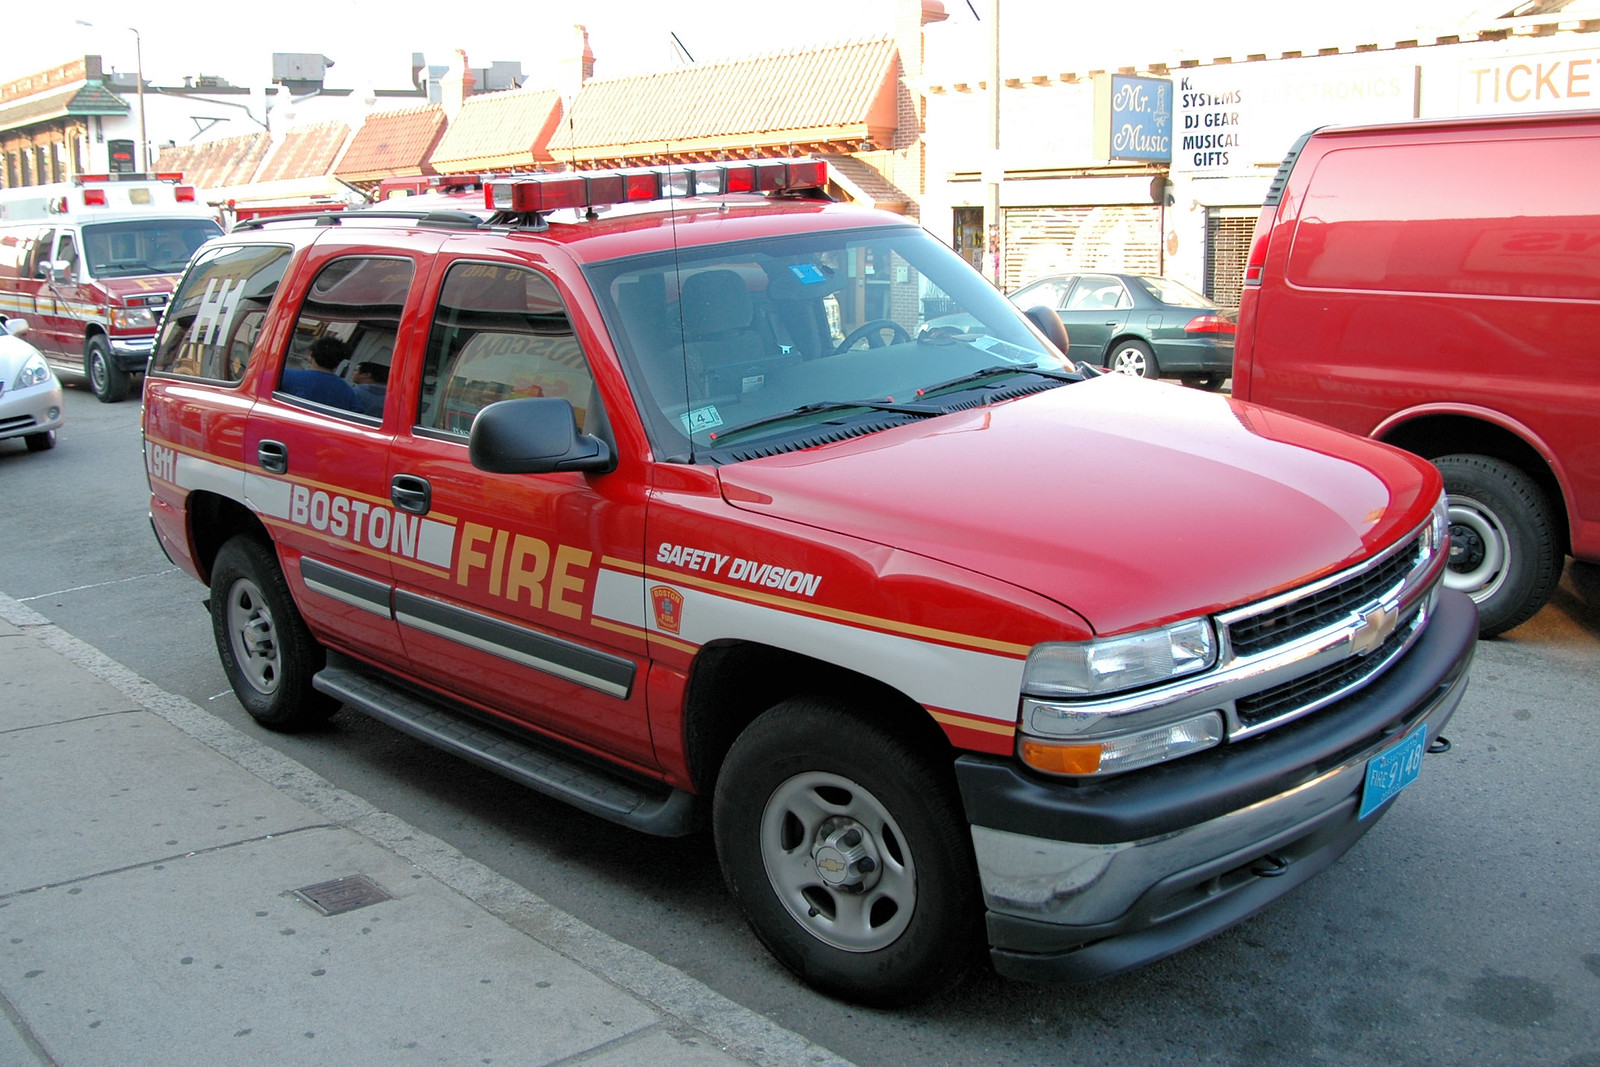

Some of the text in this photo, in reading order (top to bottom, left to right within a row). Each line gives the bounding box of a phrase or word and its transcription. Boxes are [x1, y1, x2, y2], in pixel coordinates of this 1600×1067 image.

[1469, 58, 1600, 104] TICKE
[1113, 84, 1151, 113] Mr.
[1182, 90, 1242, 108] SYSTEMS
[1185, 112, 1239, 129] DJ GEAR
[1113, 124, 1169, 153] Music
[1182, 133, 1240, 150] MUSICAL
[1194, 152, 1229, 167] GIFTS
[291, 484, 593, 620] BOSTON FIRE
[656, 542, 822, 597] SAFETY DIVISION
[653, 590, 680, 604] BOSTON
